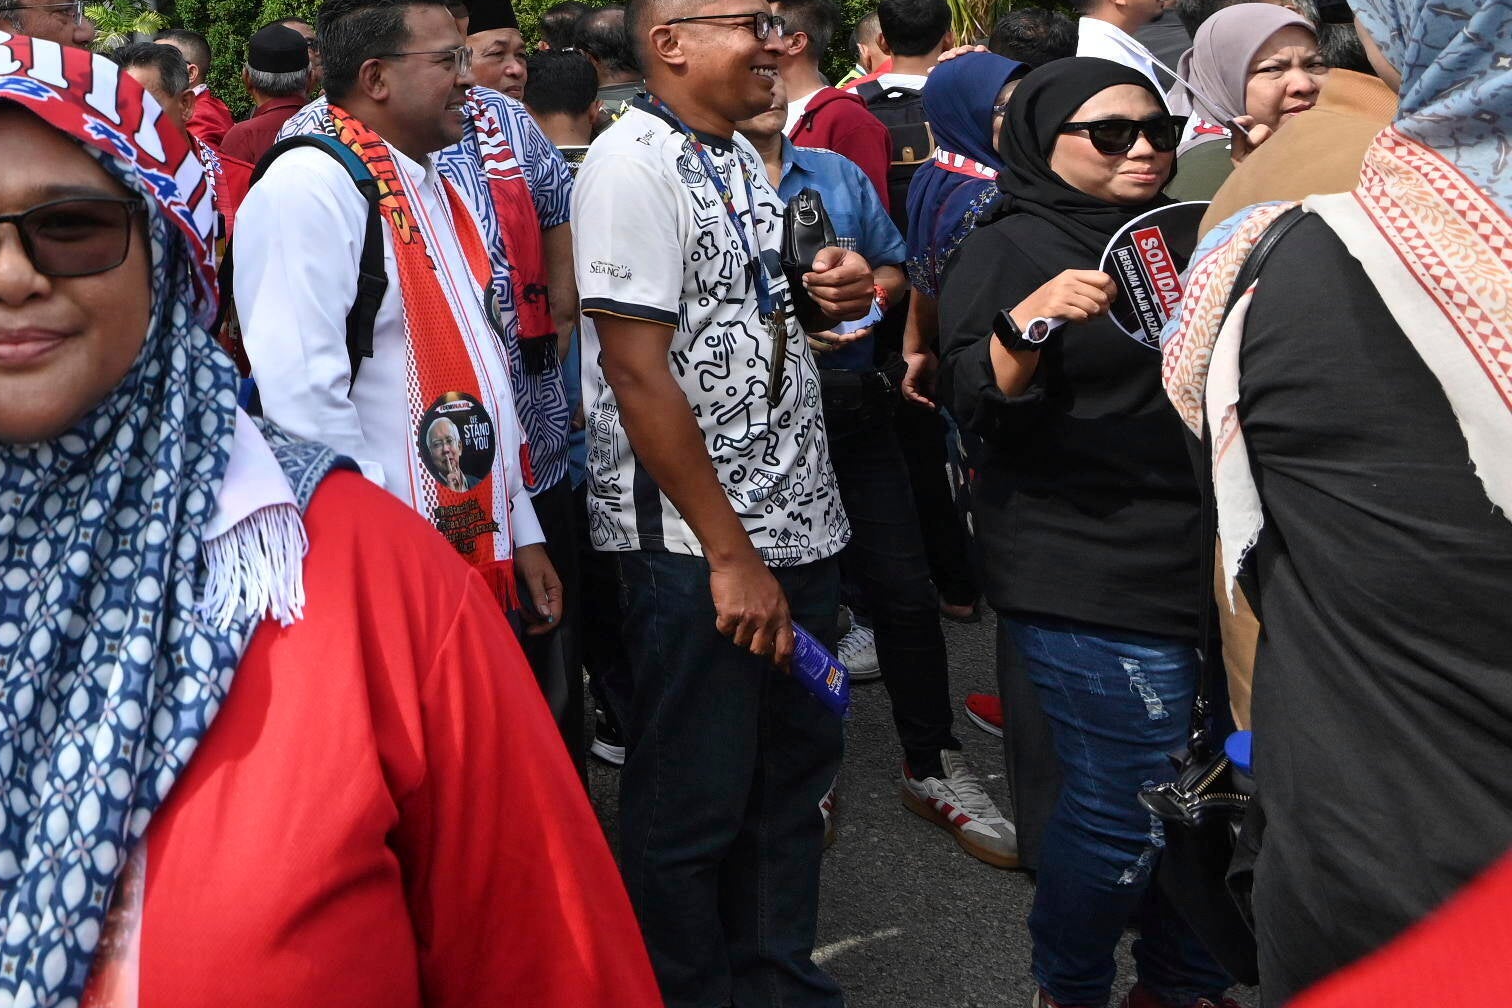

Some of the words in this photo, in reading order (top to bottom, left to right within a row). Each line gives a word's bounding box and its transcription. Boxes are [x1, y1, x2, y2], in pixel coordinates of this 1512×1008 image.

[1117, 249, 1140, 288] BERSAMA
[1133, 288, 1150, 311] NAJIB
[1142, 311, 1160, 339] RAZAK
[463, 422, 489, 438] STAND
[597, 402, 617, 435] DIE
[473, 436, 489, 450] YOU
